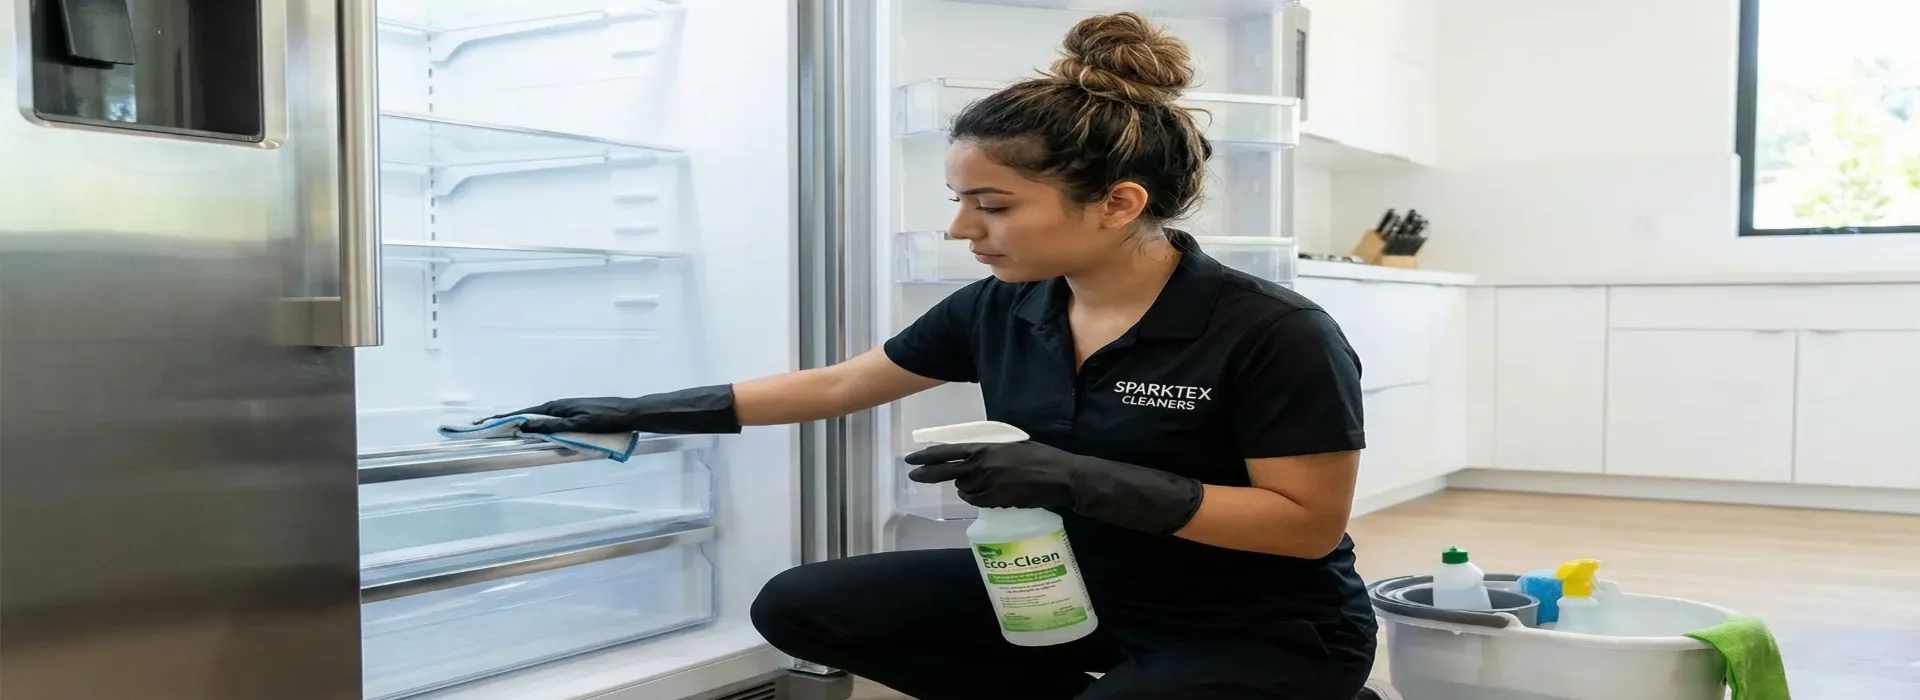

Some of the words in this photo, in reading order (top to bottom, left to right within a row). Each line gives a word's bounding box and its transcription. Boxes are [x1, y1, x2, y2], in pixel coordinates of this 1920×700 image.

[1114, 381, 1212, 400] SPARKTEX
[1121, 395, 1195, 410] CLEANERS
[983, 551, 1060, 569] Eco-Clean
